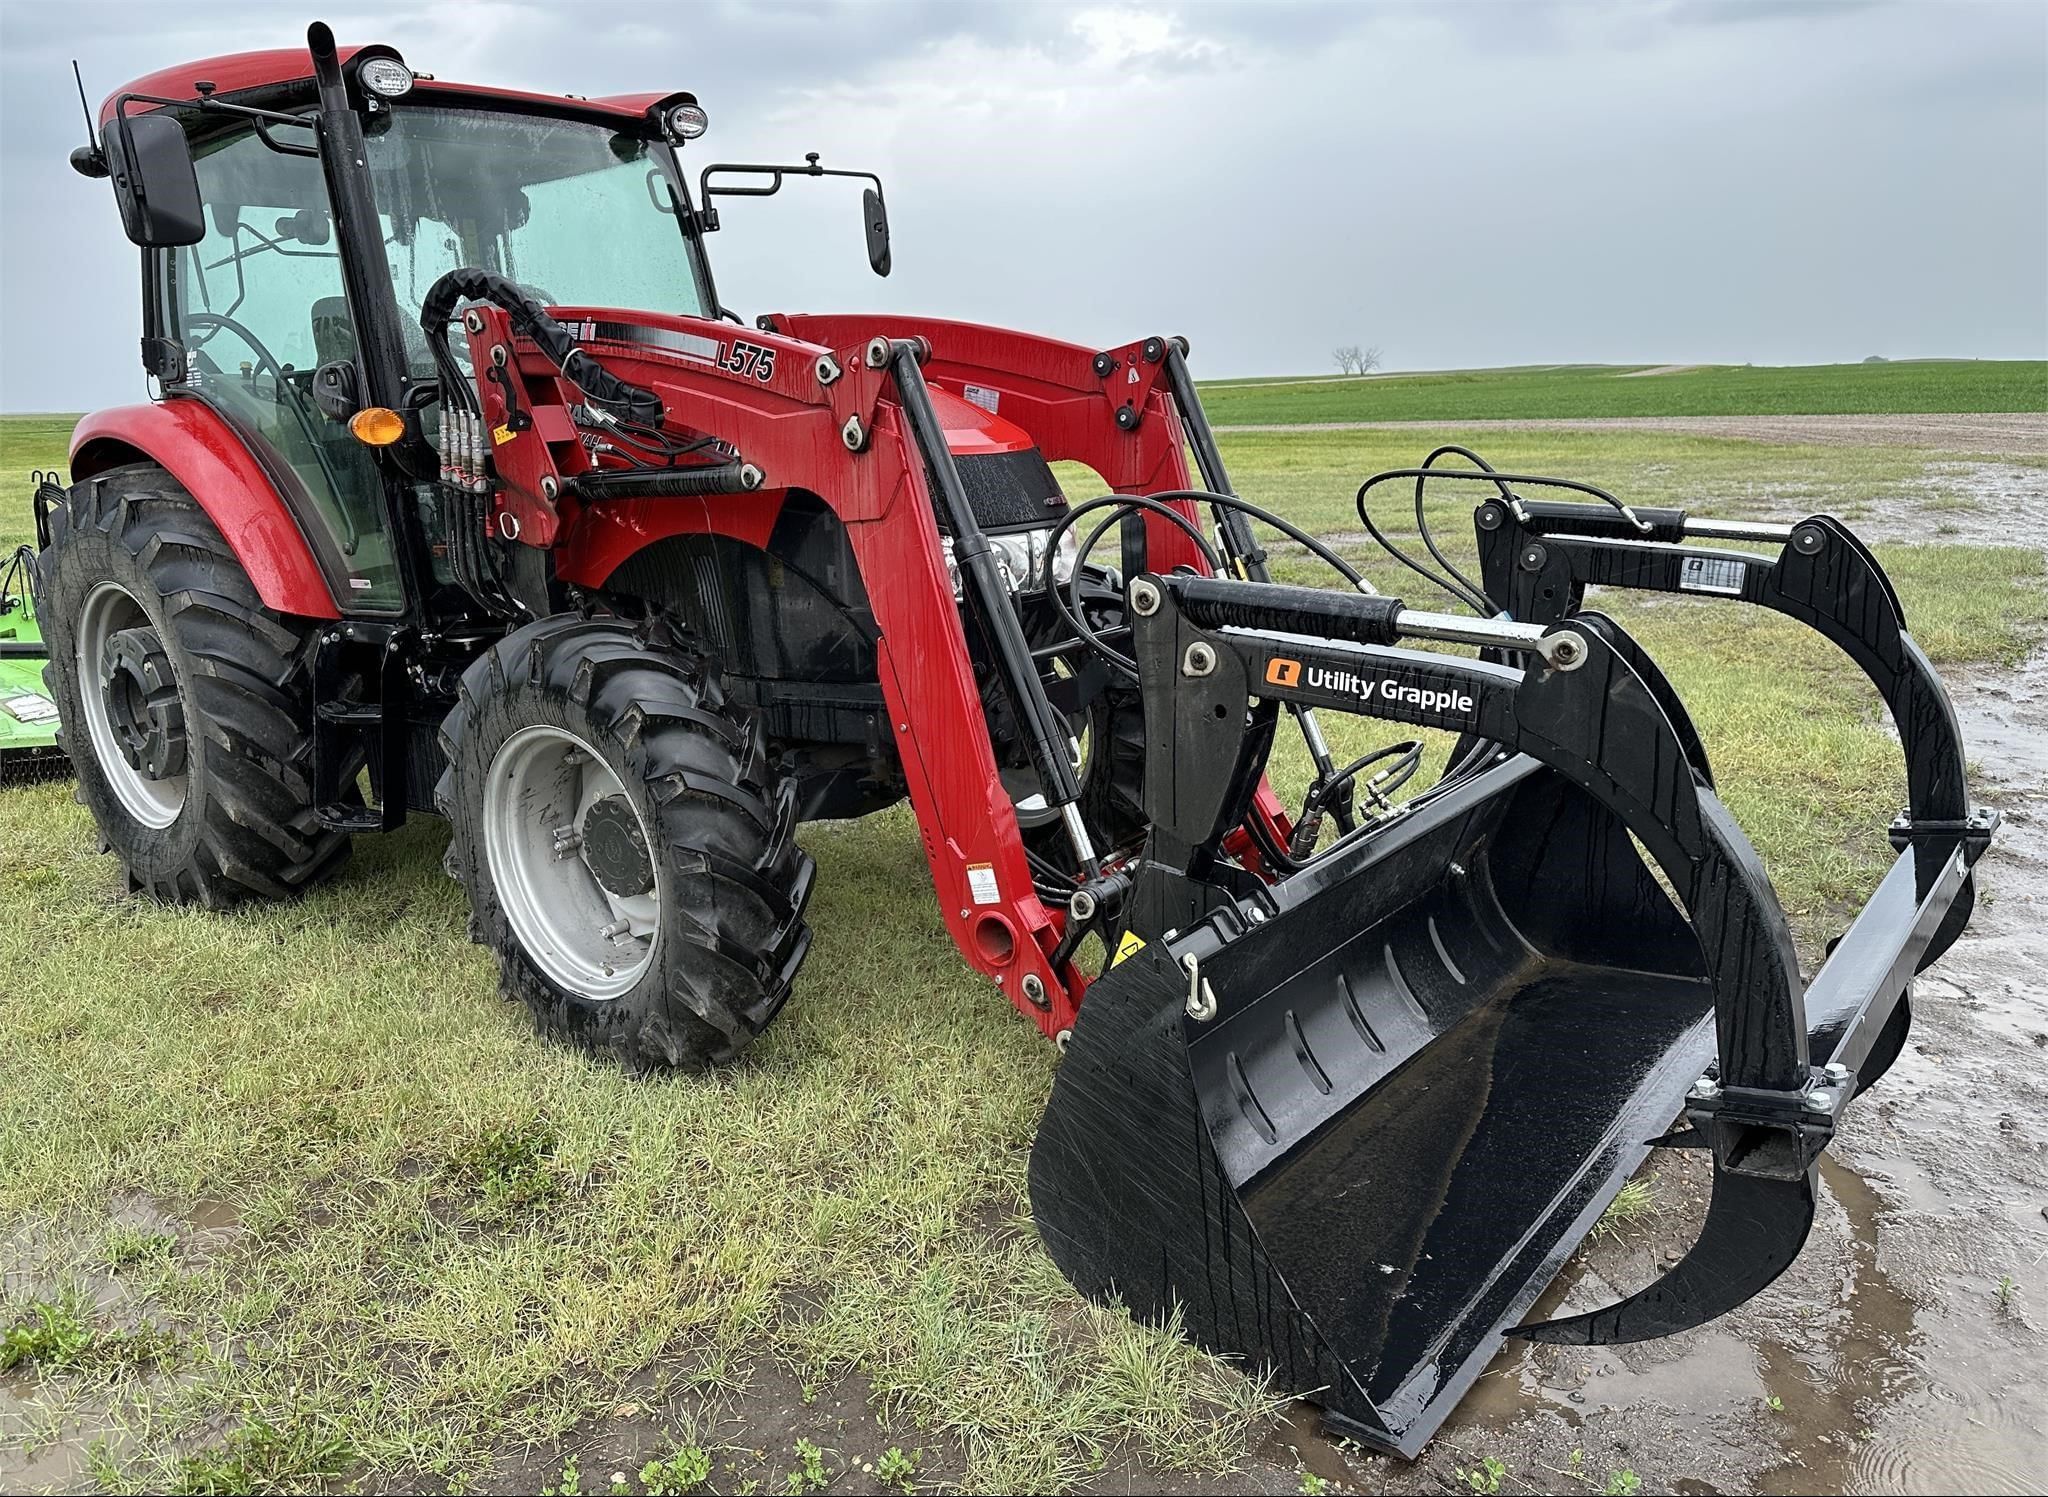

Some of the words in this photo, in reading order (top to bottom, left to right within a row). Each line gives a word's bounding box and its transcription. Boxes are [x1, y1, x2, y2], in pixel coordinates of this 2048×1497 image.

[716, 339, 777, 383] L575
[1307, 667, 1376, 699] Utility
[1380, 679, 1473, 712] Grapple
